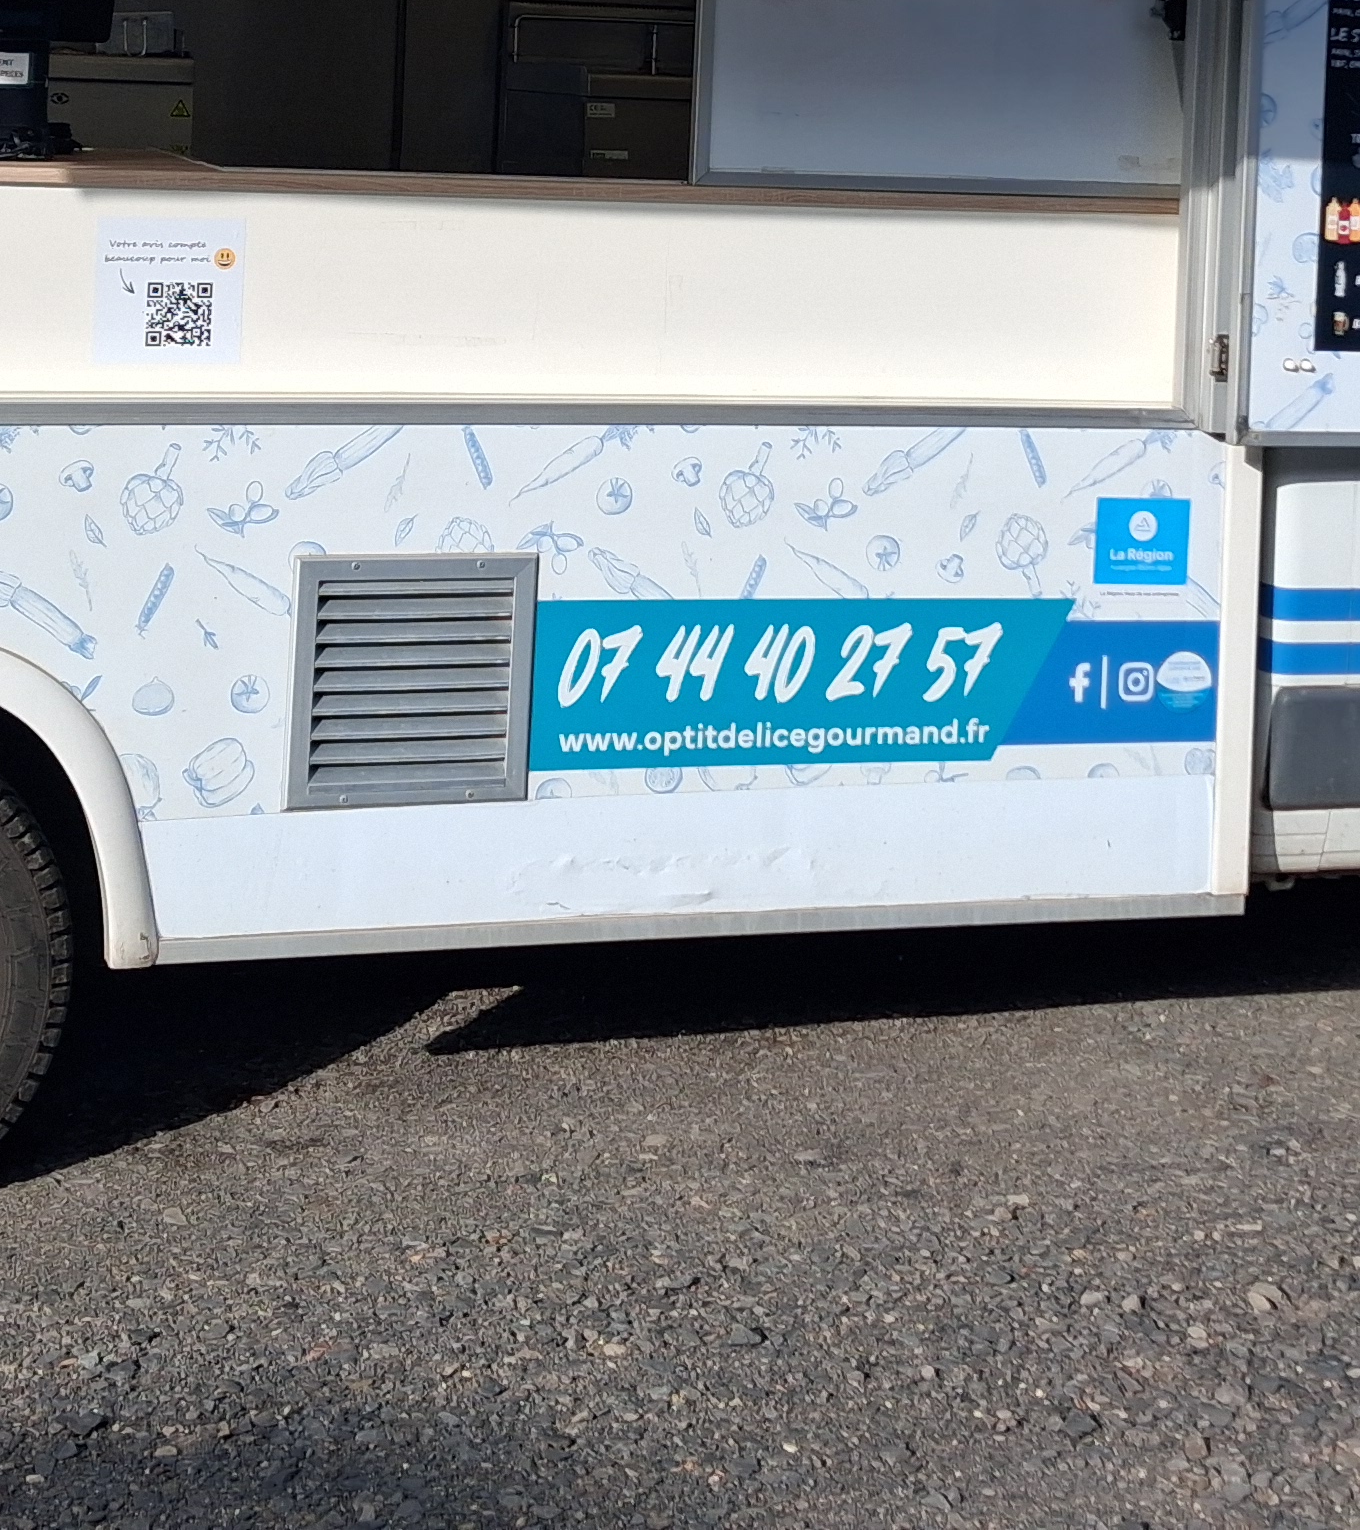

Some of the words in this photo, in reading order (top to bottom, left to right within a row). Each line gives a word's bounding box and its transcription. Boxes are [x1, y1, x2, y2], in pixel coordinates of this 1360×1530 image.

[1330, 28, 1350, 41] LE
[109, 239, 137, 249] Votre
[142, 240, 164, 249] avis
[168, 240, 206, 251] compte
[104, 254, 156, 265] beaucoup
[160, 255, 186, 265] pour
[191, 255, 211, 263] moi
[1110, 548, 1125, 561] La
[1127, 548, 1174, 563] Région
[557, 625, 643, 708] 07
[656, 623, 735, 703] 44
[745, 623, 816, 703] 40
[826, 622, 913, 702] 27
[922, 622, 1003, 702] 57
[559, 719, 990, 756] www.optitdelicegourmand.fr
